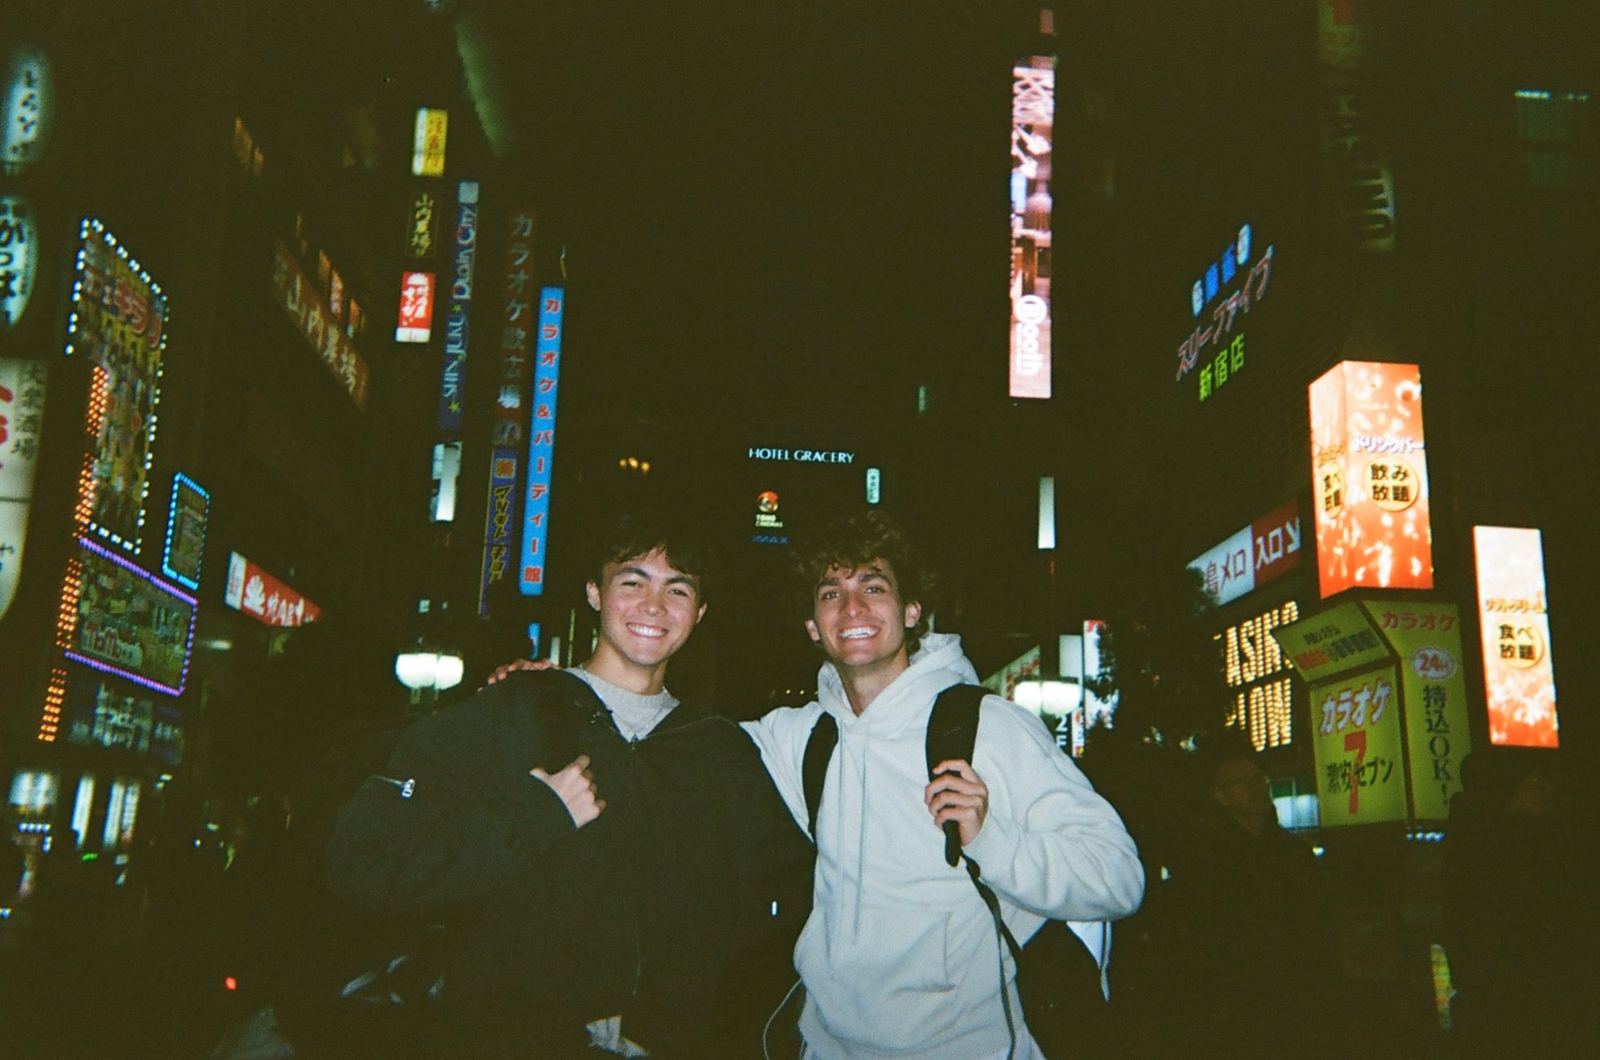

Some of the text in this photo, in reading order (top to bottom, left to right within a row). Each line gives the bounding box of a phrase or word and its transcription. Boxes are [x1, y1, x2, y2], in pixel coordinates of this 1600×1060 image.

[1199, 332, 1246, 402] 新宿店
[749, 448, 855, 463] HOTEL GRACERY
[1370, 464, 1410, 481] 飲み
[1371, 484, 1411, 503] 放題
[1382, 610, 1457, 632] カラオケ
[1498, 623, 1535, 641] 食べ
[1320, 678, 1391, 736] カラオケ
[1344, 730, 1367, 815] 7
